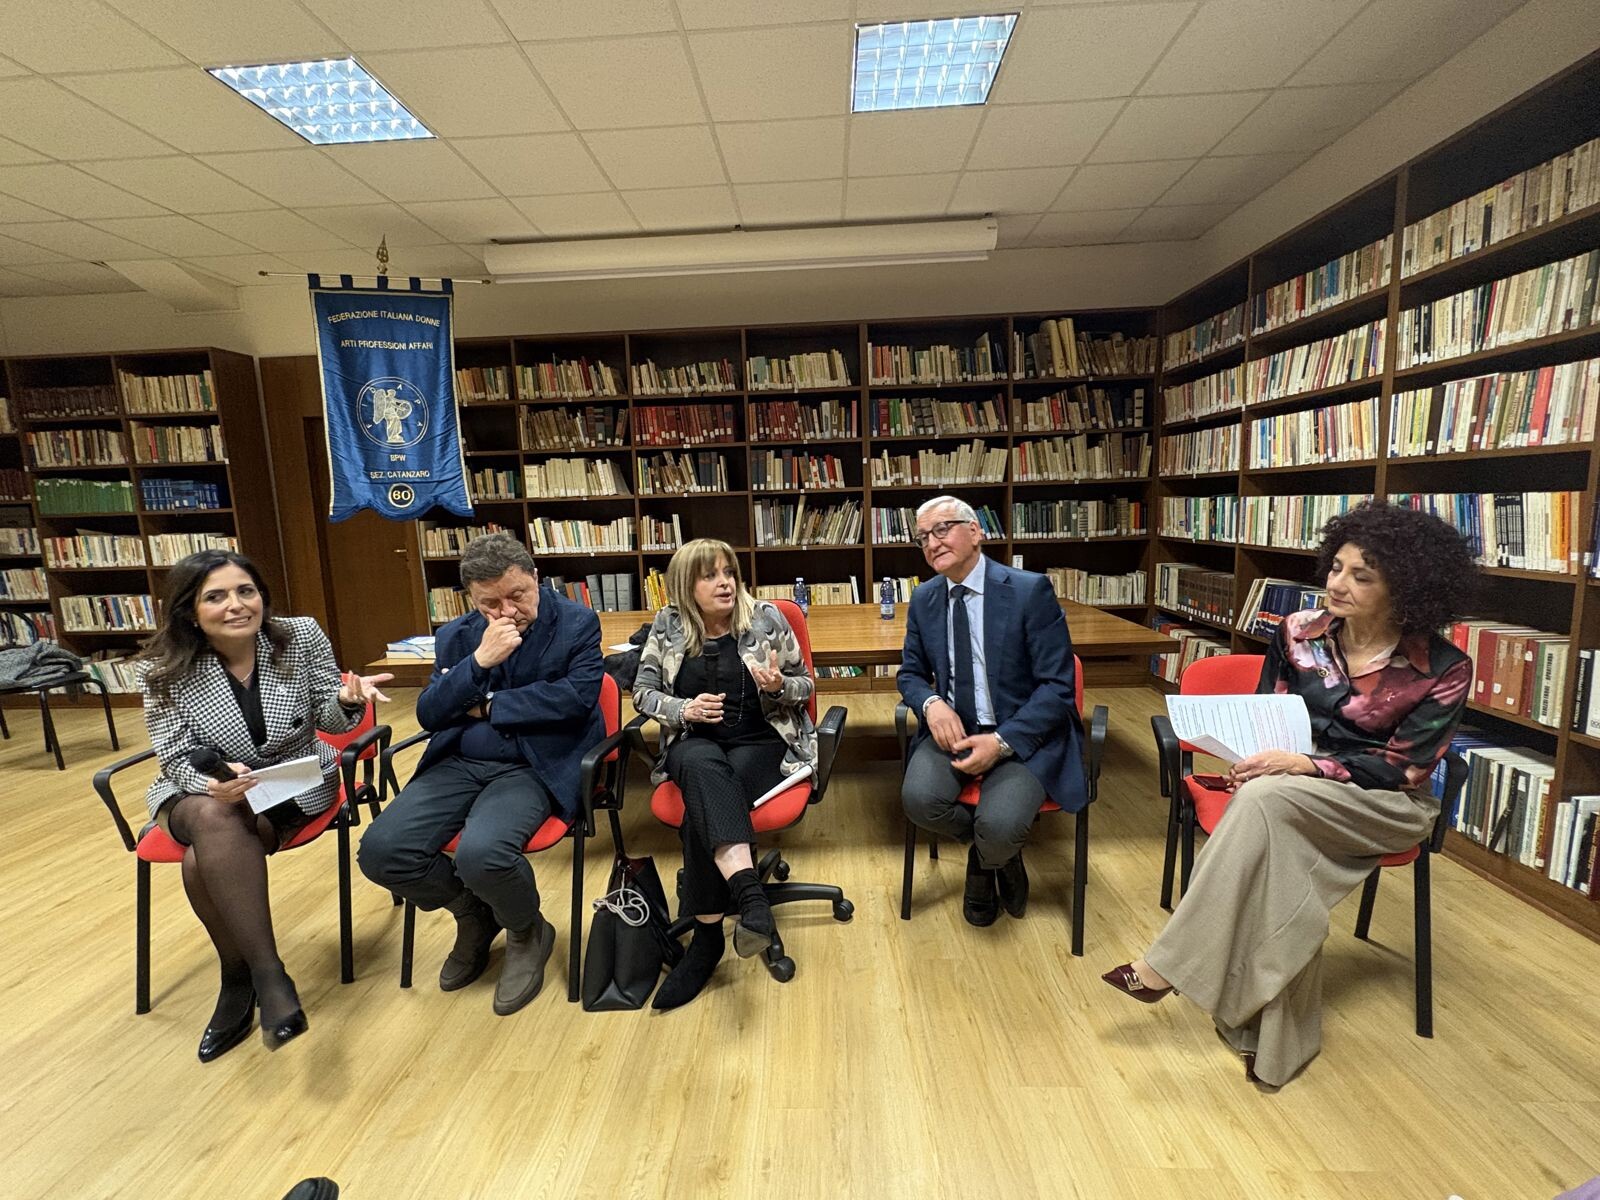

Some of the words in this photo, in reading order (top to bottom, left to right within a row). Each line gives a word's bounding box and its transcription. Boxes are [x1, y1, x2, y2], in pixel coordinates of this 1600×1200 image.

[327, 310, 379, 324] FEDERAZIONE
[380, 310, 414, 321] ITALIANA
[415, 315, 441, 327] DONNE
[358, 340, 407, 350] PROFESSIONI
[408, 342, 434, 350] AFFARI
[387, 470, 430, 478] CATANZARO
[392, 490, 411, 500] 60
